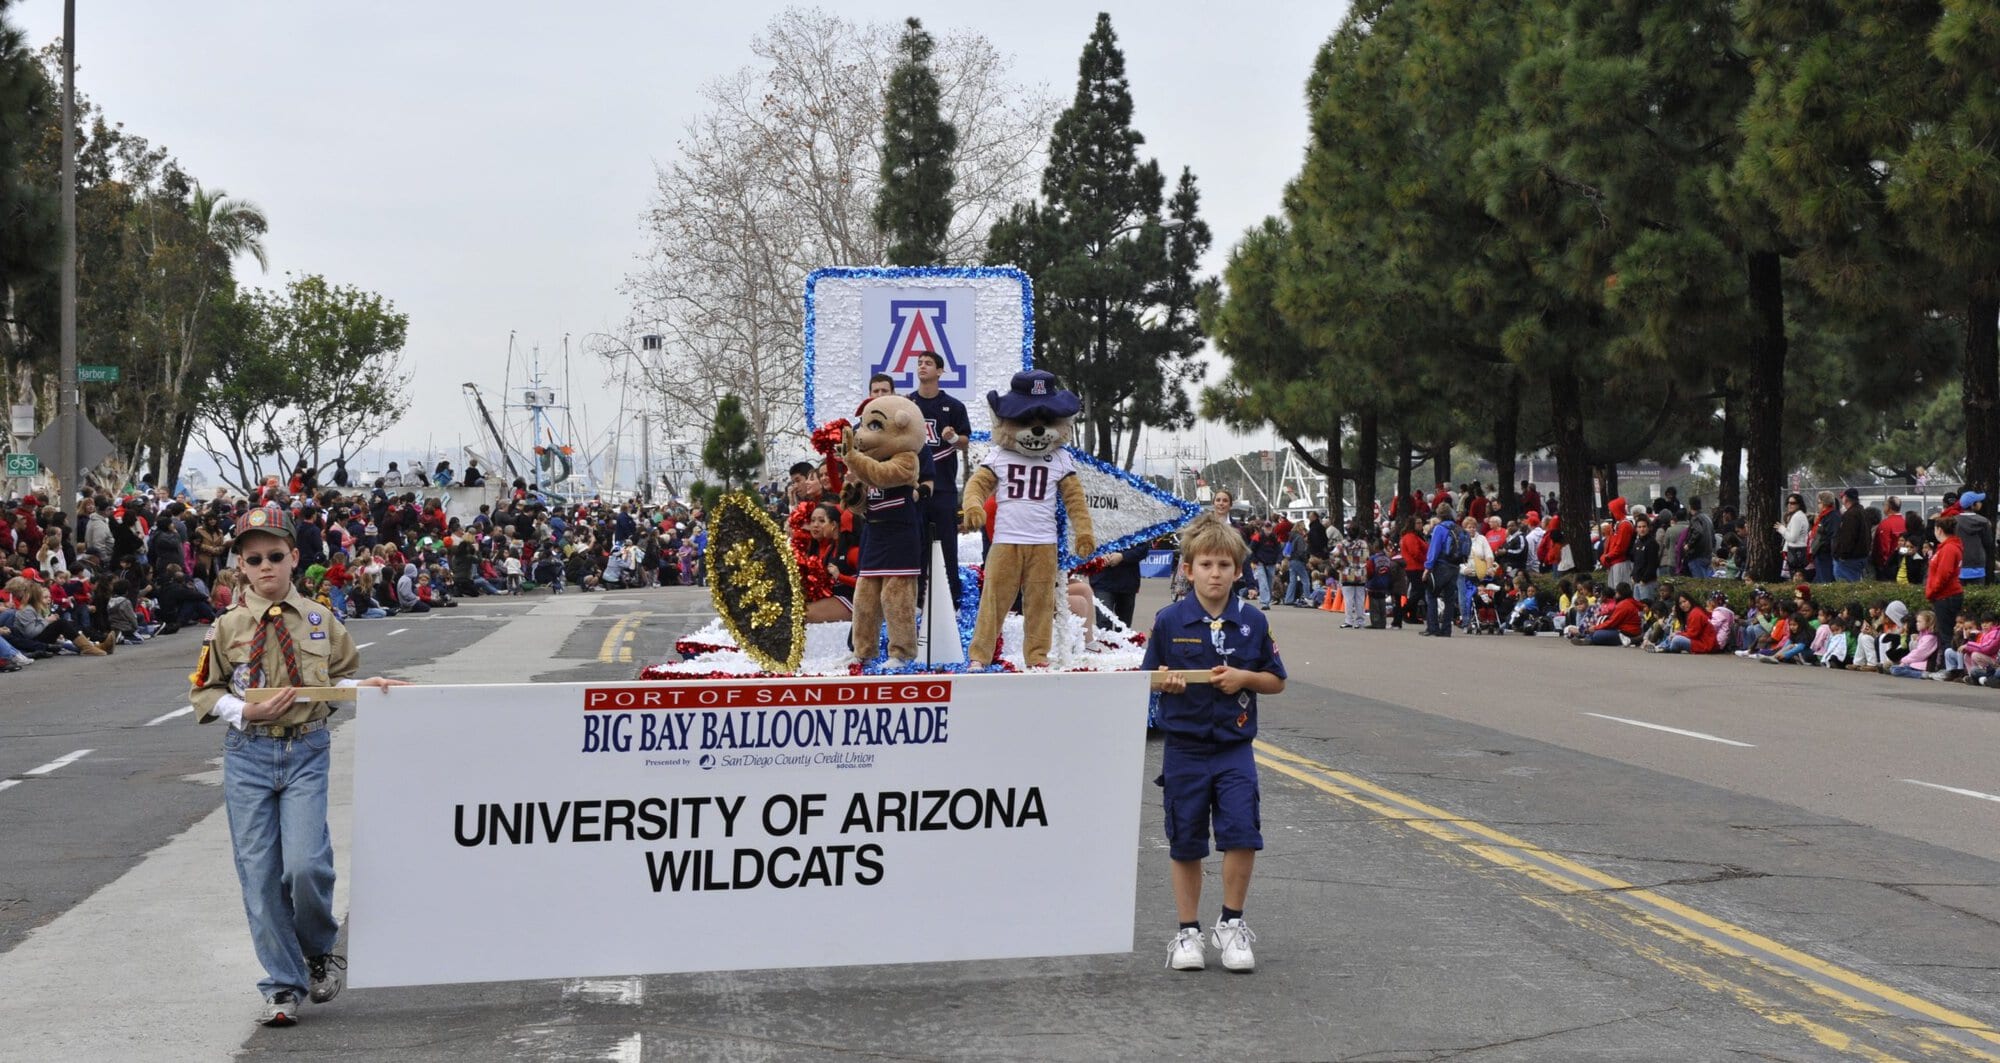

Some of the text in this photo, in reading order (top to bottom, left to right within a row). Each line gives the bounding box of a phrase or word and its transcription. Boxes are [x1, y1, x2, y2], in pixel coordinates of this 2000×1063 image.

[871, 300, 966, 388] A
[78, 367, 106, 379] Harbor
[1008, 463, 1049, 501] 50
[590, 685, 946, 706] PORT OF SAN DIEGO
[582, 706, 949, 753] BIG BAY BALLOON PARADE
[682, 758, 691, 767] by
[721, 752, 875, 768] San Diego County Credit Union
[454, 787, 1048, 847] UNIVERSITY OF ARIZONA
[645, 843, 884, 892] WILDCATS
